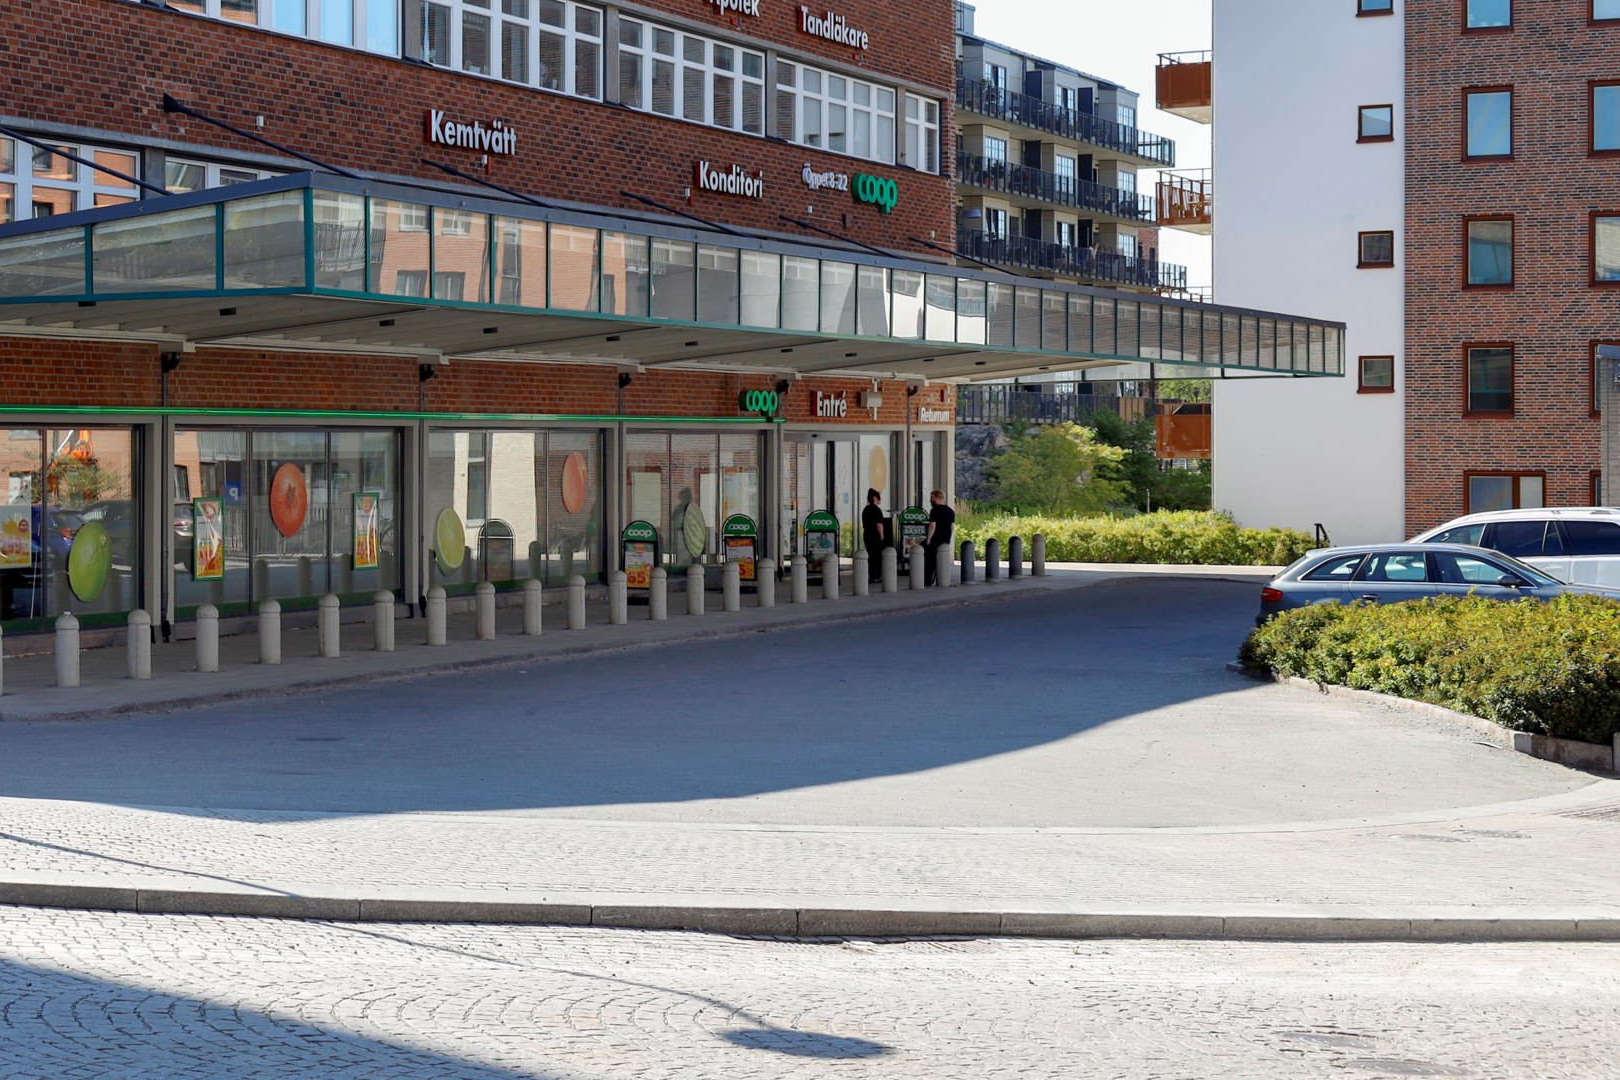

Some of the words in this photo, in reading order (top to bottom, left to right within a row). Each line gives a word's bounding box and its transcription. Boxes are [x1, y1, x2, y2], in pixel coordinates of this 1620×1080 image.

[798, 5, 869, 51] Tandläkare
[426, 109, 517, 156] Kemtvätt
[697, 160, 764, 199] Konditori
[855, 173, 899, 214] coop
[744, 390, 778, 416] coop
[814, 390, 847, 418] Entré
[628, 529, 653, 538] coop
[904, 513, 926, 521] coop
